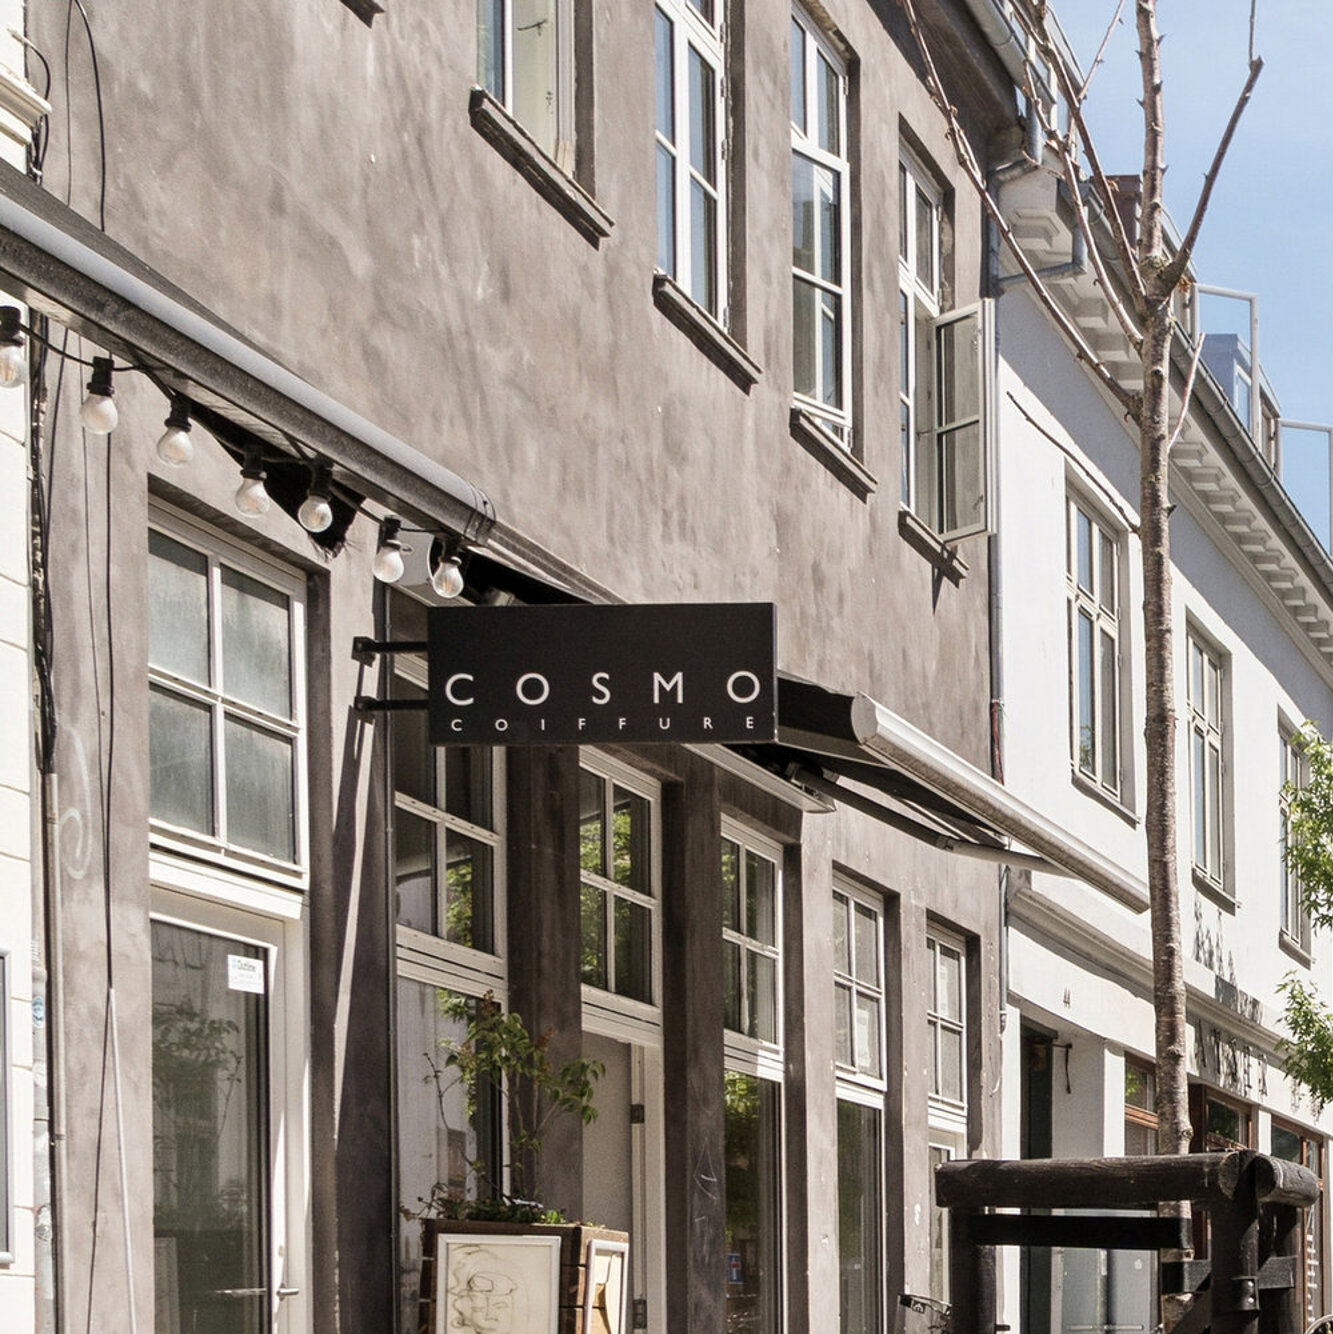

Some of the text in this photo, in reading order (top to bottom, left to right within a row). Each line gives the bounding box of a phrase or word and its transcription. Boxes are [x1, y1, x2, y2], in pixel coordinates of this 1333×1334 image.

[444, 670, 761, 706] COSMO
[451, 716, 755, 732] COIFFURE
[1063, 986, 1071, 1009] 44
